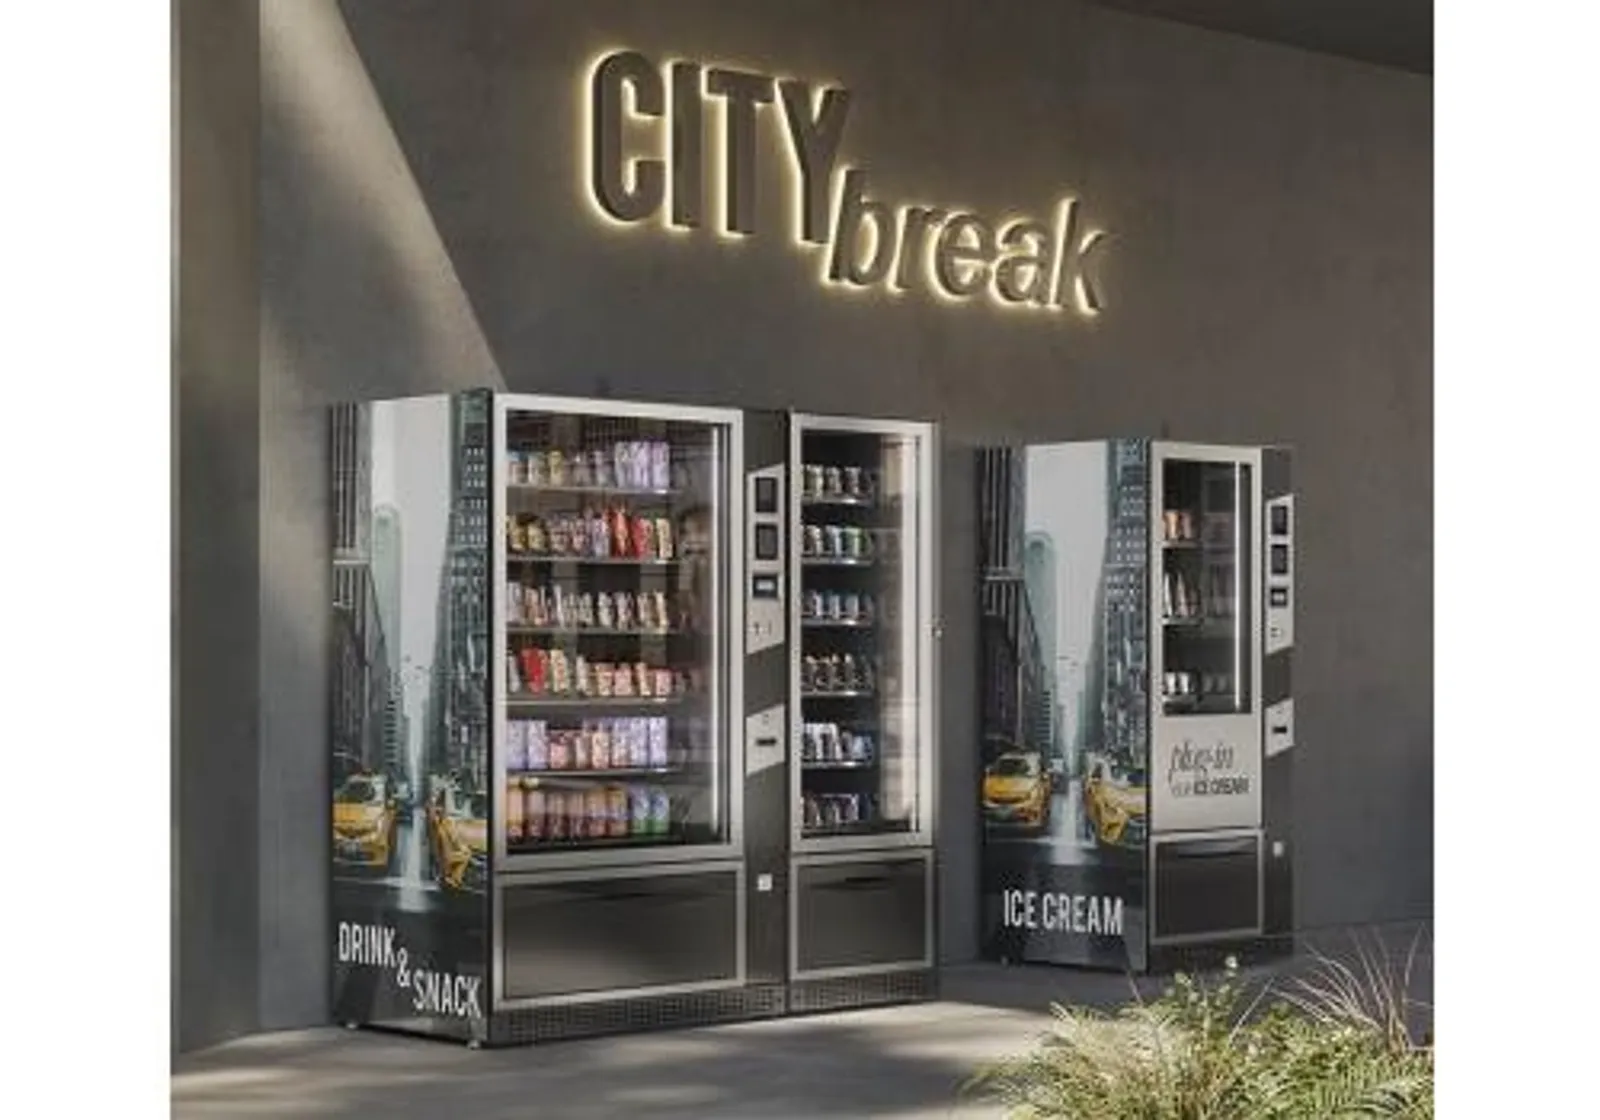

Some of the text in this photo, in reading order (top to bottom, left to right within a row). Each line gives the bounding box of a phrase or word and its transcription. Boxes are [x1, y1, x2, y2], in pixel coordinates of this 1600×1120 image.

[590, 50, 1110, 313] CITY break
[1004, 889, 1123, 936] ICE CREAM
[338, 921, 481, 1019] DRINK & SNACK
